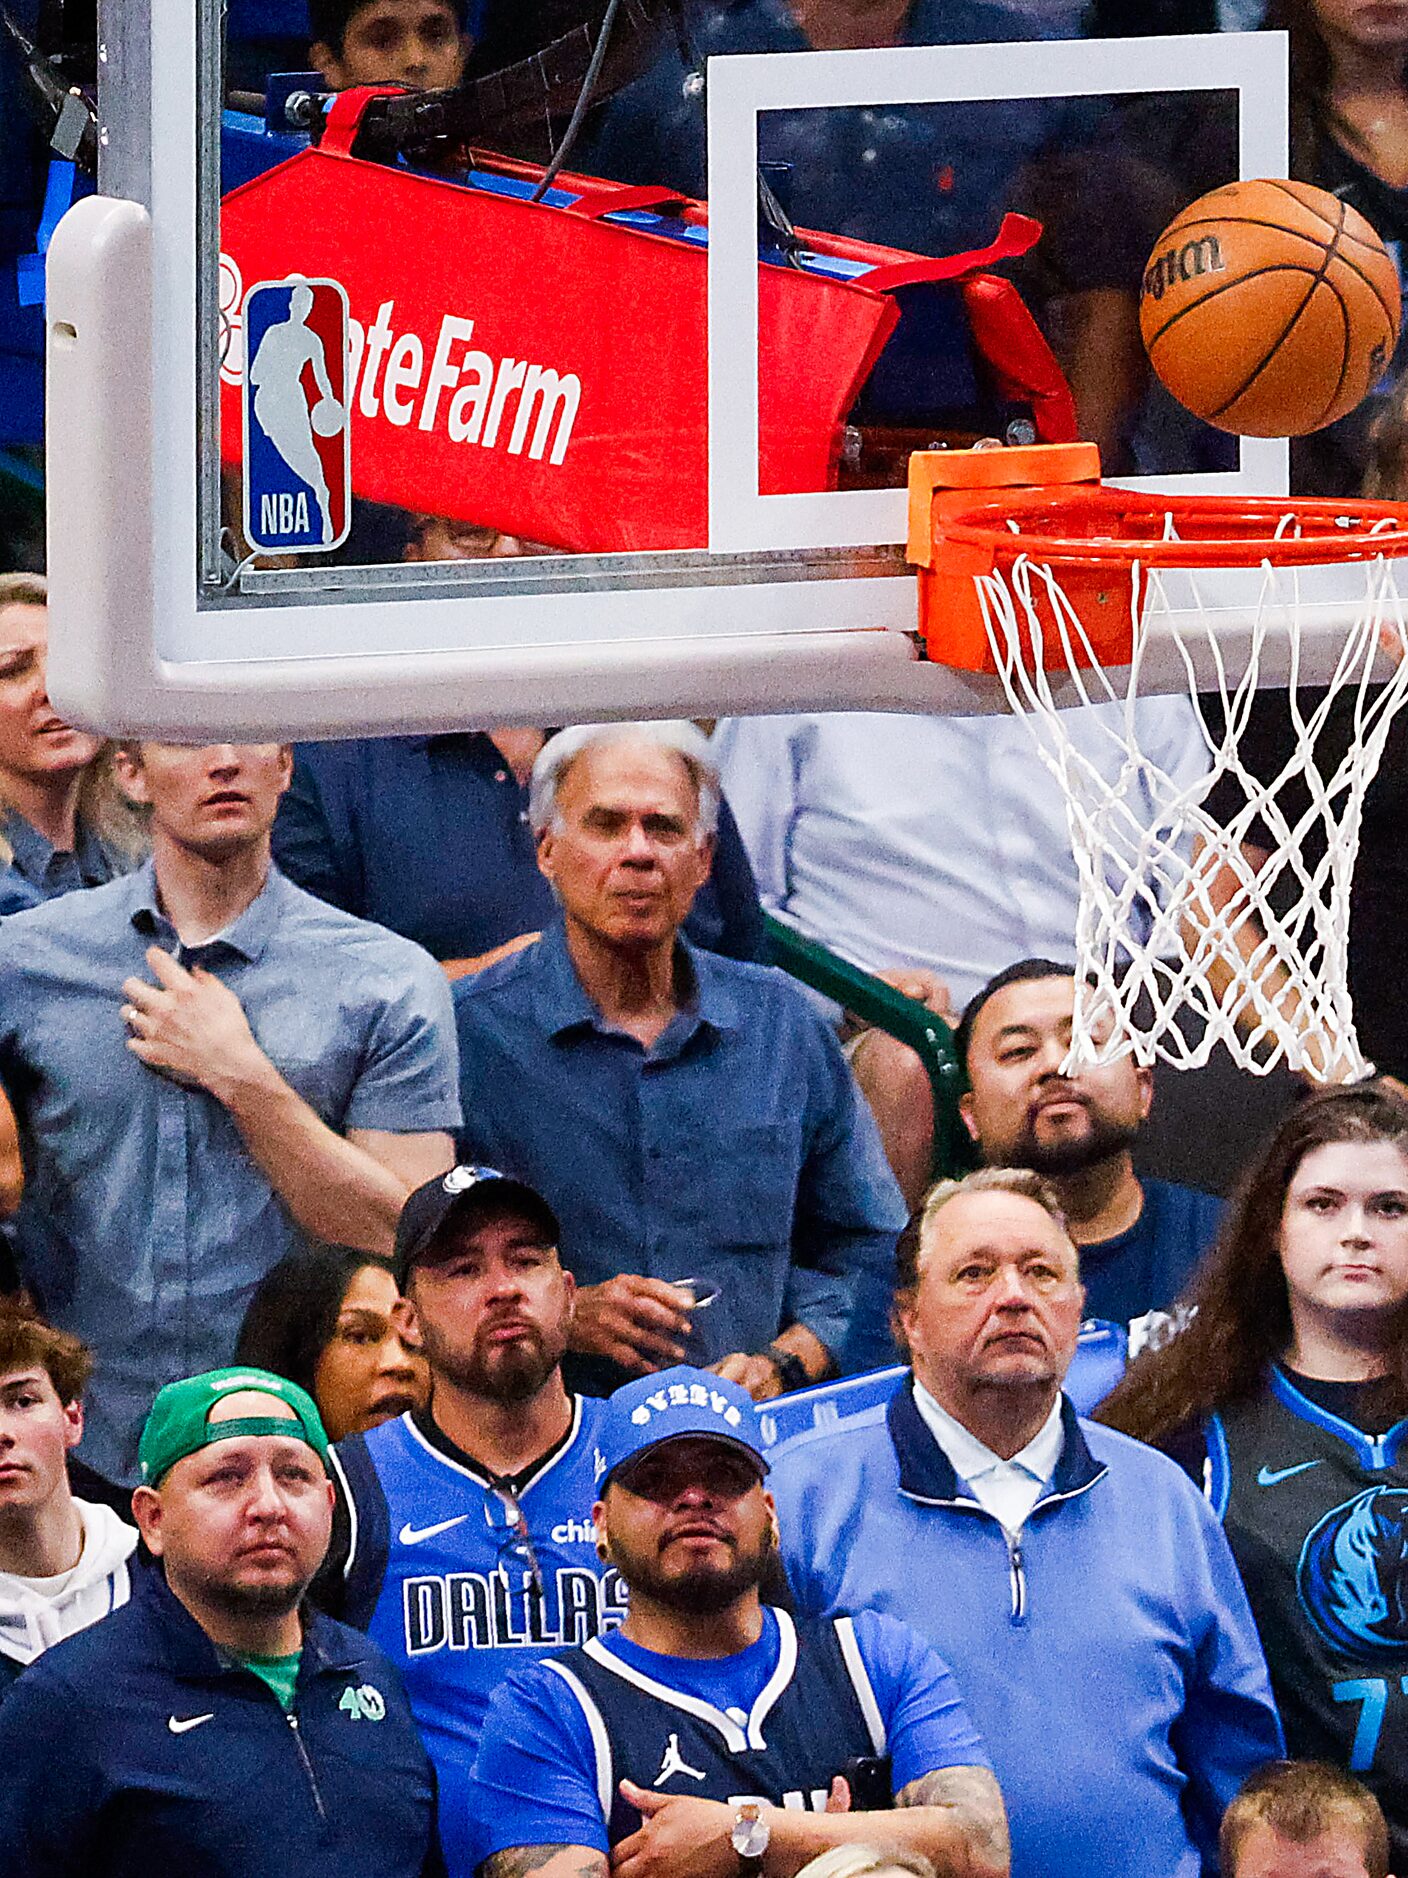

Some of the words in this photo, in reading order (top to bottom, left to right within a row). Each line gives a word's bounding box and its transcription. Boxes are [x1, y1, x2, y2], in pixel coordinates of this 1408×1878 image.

[260, 492, 309, 535] NBA
[551, 1518, 600, 1545] chi
[403, 1567, 630, 1657] DALLAS
[338, 1683, 386, 1721] 40
